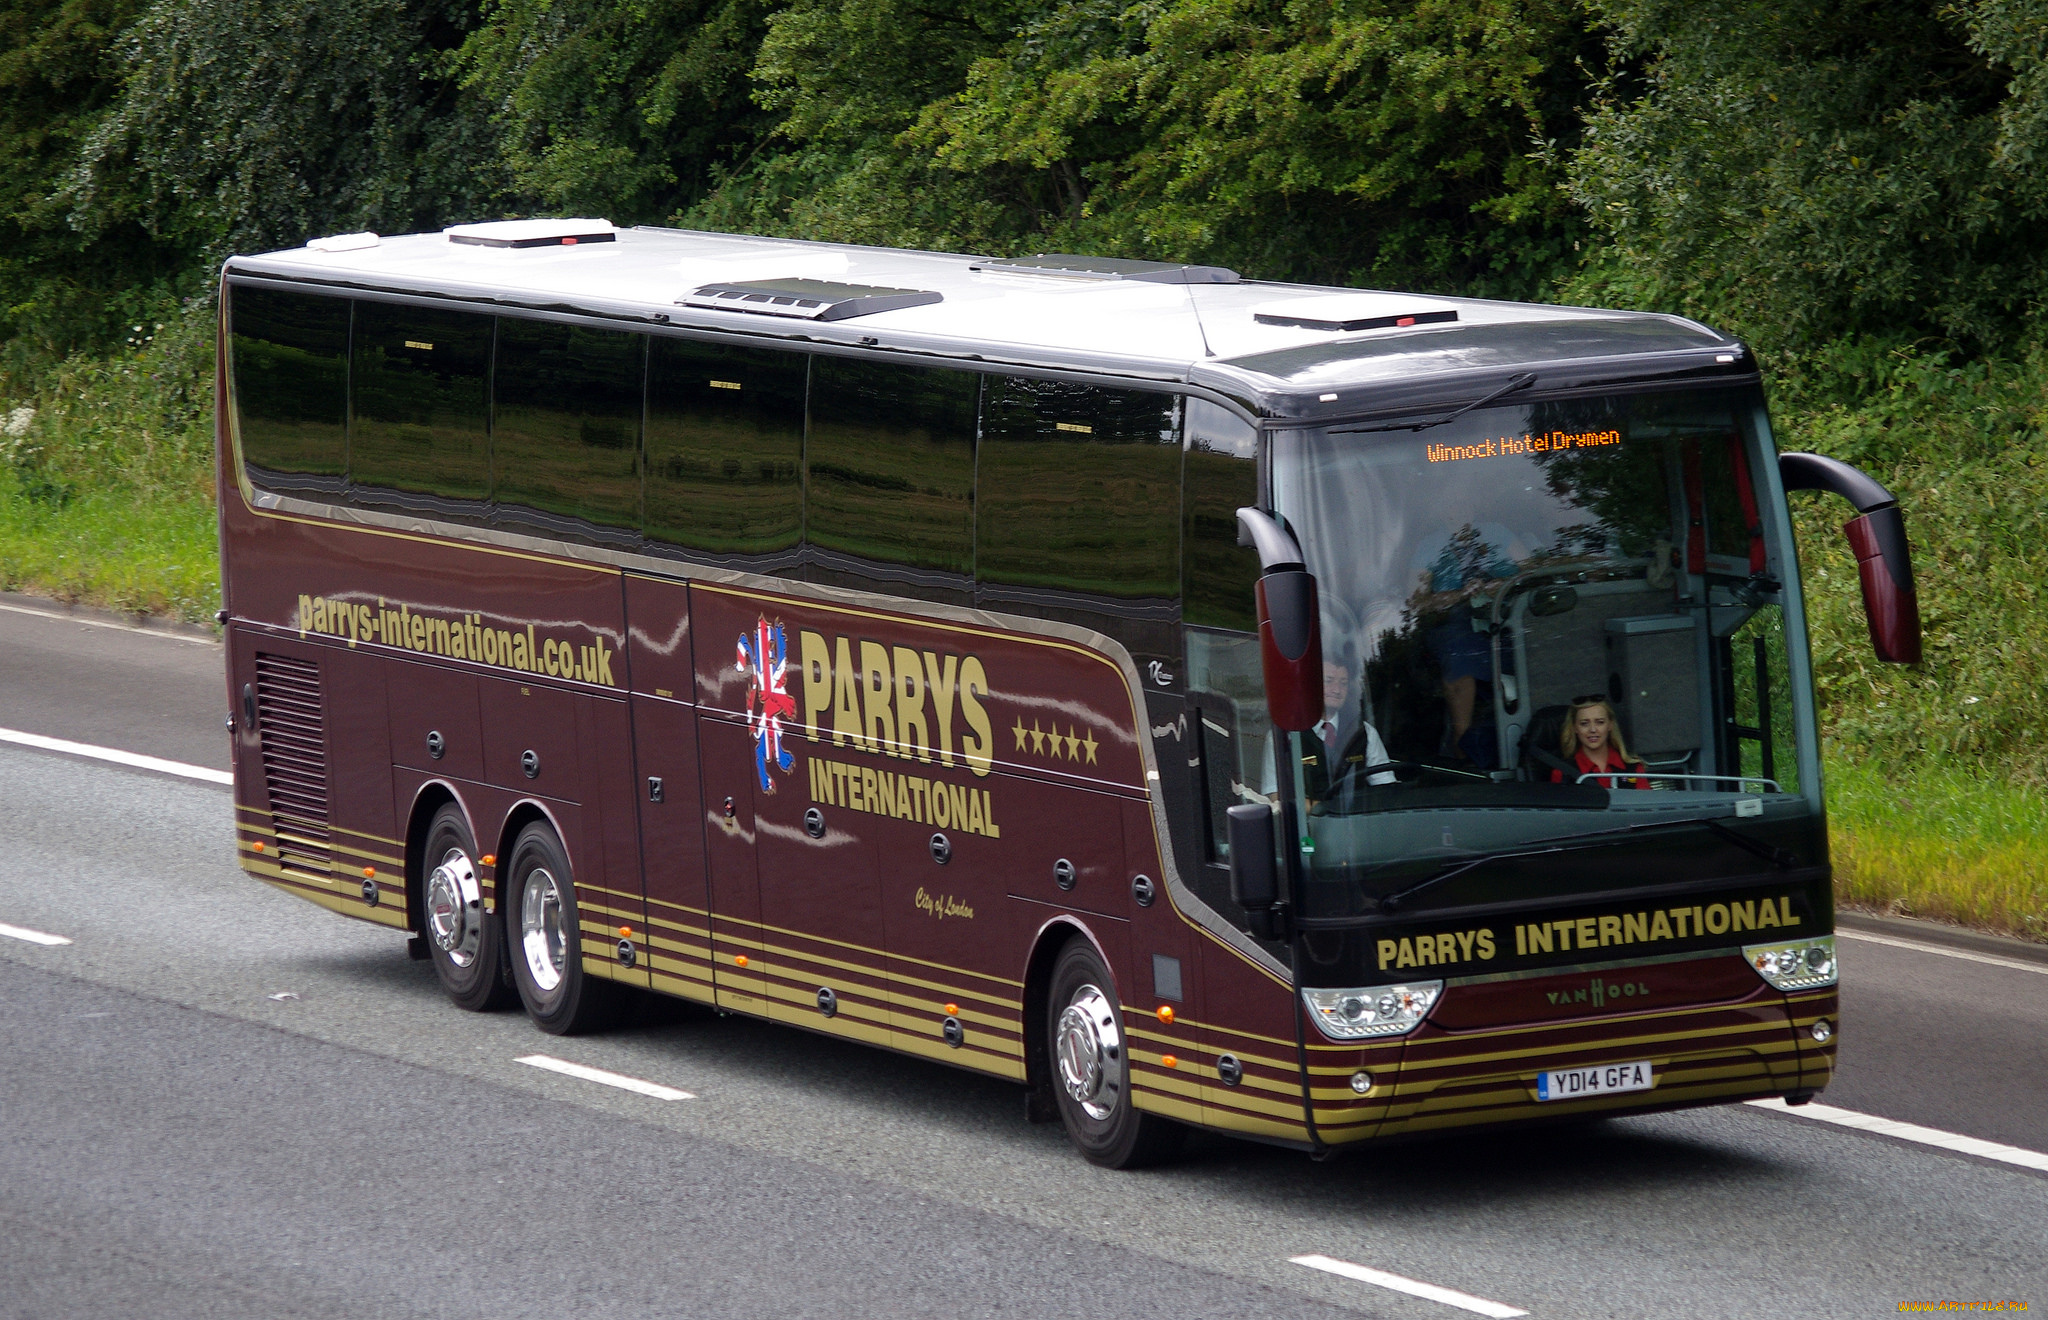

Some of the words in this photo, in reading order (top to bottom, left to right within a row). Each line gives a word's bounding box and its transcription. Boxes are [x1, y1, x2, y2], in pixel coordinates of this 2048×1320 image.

[1427, 439, 1497, 462] Winnock
[1500, 434, 1549, 456] Hotel
[1552, 430, 1620, 450] Drymen
[298, 594, 615, 686] parrys-international.co.uk
[801, 630, 993, 777] PARRYS
[808, 757, 1000, 838] INTERNATIONAL
[915, 887, 934, 916] City
[935, 894, 944, 919] of
[944, 895, 974, 919] London
[1378, 929, 1496, 971] PARRYS
[1516, 897, 1800, 955] INTERNATIONAL
[1555, 1070, 1600, 1093] YD14
[1605, 1065, 1645, 1088] GFA
